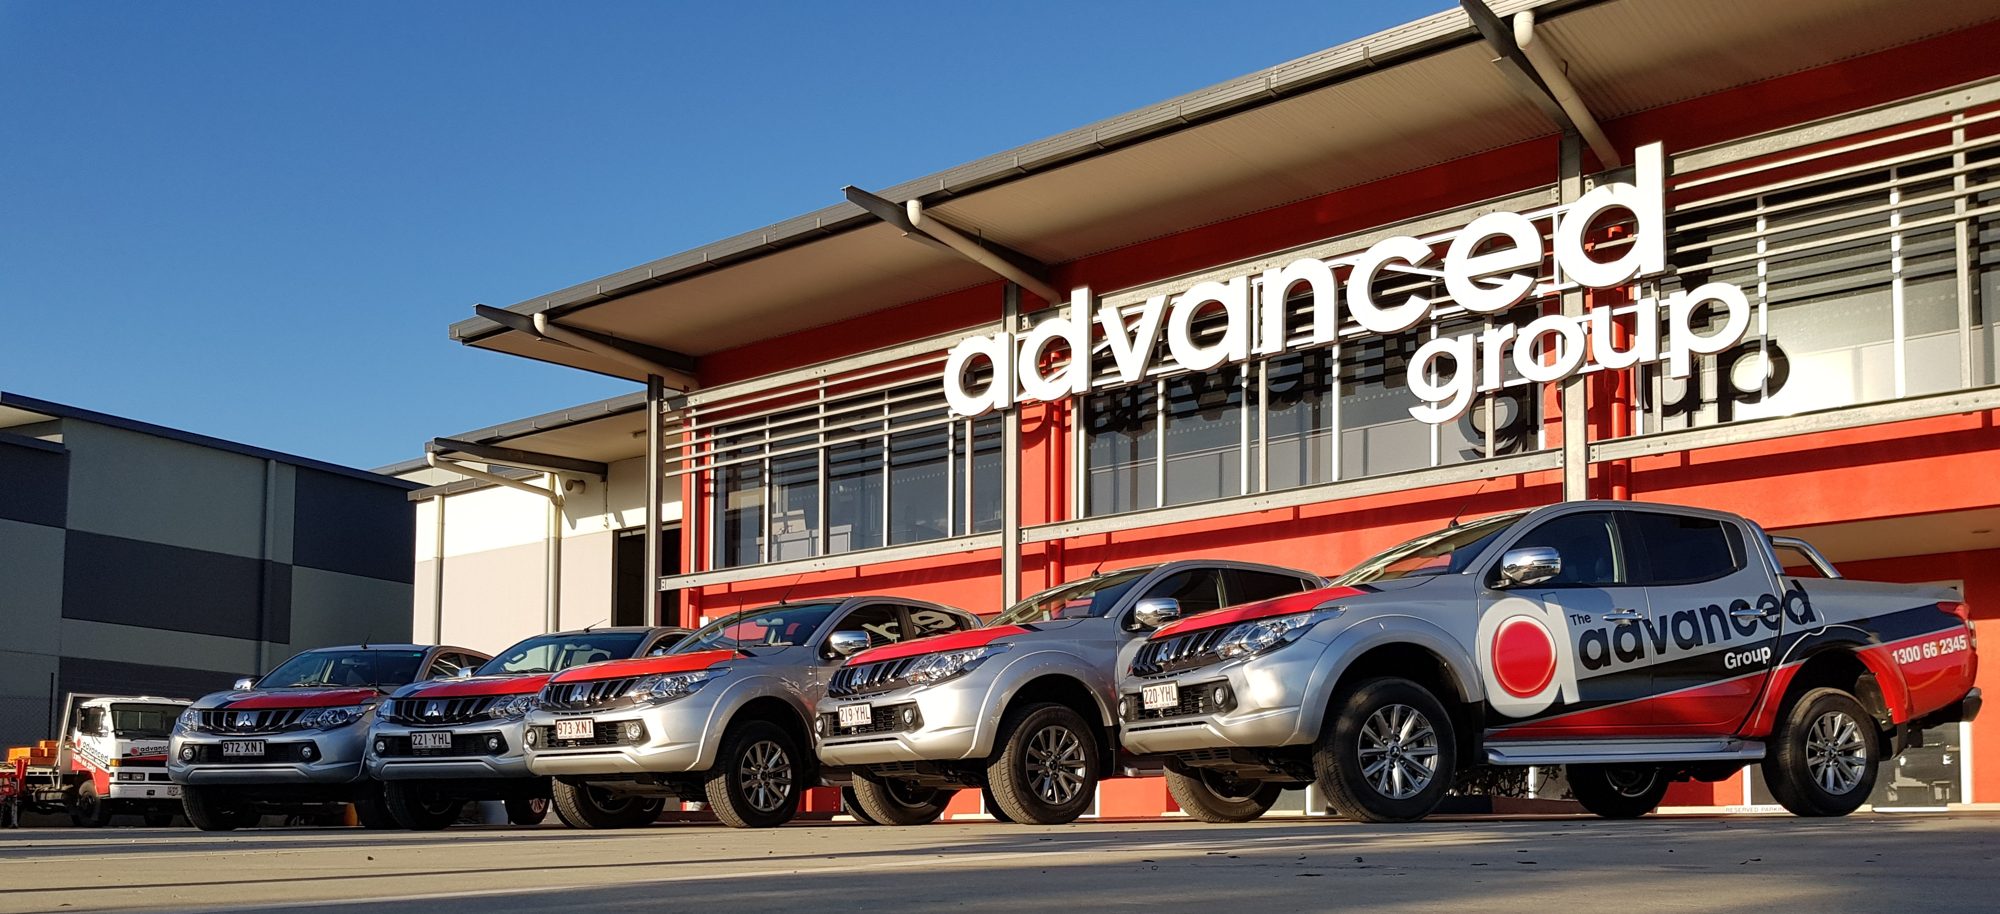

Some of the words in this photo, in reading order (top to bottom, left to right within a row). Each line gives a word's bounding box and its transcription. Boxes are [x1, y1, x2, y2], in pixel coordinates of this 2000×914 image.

[942, 141, 1666, 418] advanced
[1406, 281, 1751, 425] group
[1569, 613, 1592, 627] The
[1578, 579, 1817, 671] advanced
[1892, 645, 1921, 664] 1300
[1922, 641, 1938, 659] 66
[1939, 634, 1968, 655] 2345
[1724, 646, 1772, 670] Group
